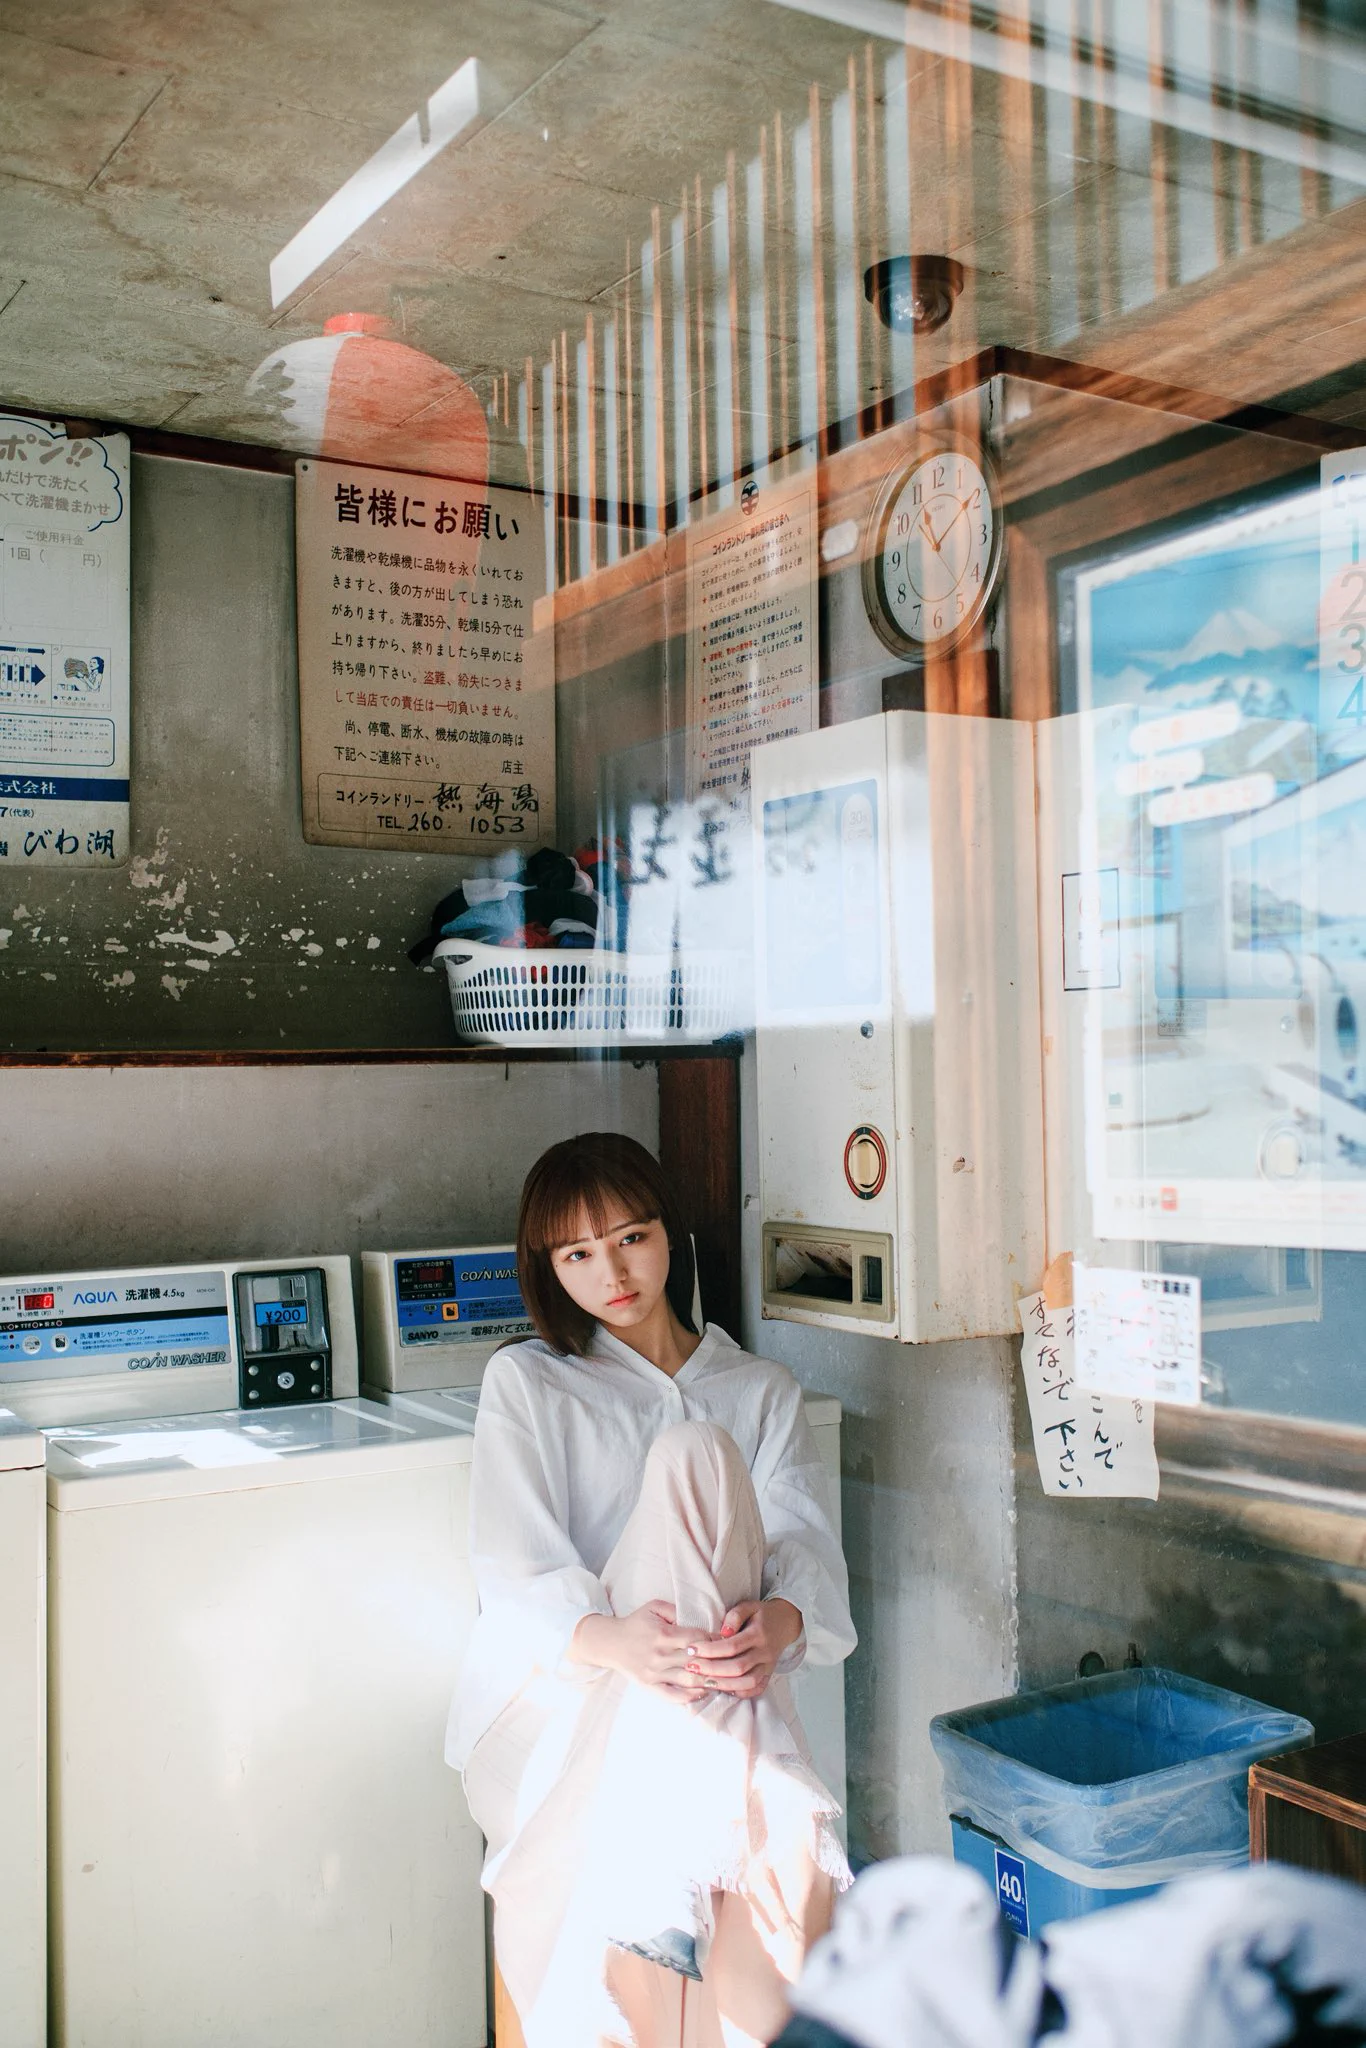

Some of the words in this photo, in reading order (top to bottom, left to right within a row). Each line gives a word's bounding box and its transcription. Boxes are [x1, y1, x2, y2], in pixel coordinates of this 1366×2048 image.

[931, 465, 945, 489] 12
[957, 469, 962, 490] 1
[912, 483, 923, 505] 11
[973, 488, 981, 509] 2
[334, 483, 519, 540] 皆様にお願い
[896, 512, 909, 536] 10
[979, 524, 987, 546] 3
[24, 530, 84, 546] ご使用料金
[331, 545, 523, 581] 洗濯機や乾燥機に品物を永くいれてお
[892, 551, 900, 572] 9
[971, 563, 980, 583] 4
[333, 574, 523, 609] きますと、後の方が出してしまう恐れ
[897, 584, 906, 605] 8
[956, 593, 964, 614] 5
[331, 603, 524, 638] があります。洗濯35分、乾燥15分で仕
[912, 604, 922, 626] 7
[933, 608, 942, 629] 6
[331, 631, 523, 663] 上りますから、終りましたら早めにお
[1337, 622, 1366, 674] 3
[332, 660, 523, 692] 持ち帰り下さい。盗難、紛失につきま
[335, 689, 519, 719] して当店での責任は一切負いません。
[1336, 675, 1366, 726] 4
[345, 720, 524, 746] 尚、停電、断水、機械の故障の時は
[334, 746, 441, 769] 下記へご連絡下さい。
[501, 760, 524, 775] 店主
[0, 780, 57, 795] 式会社
[336, 790, 424, 808] コインランドリー
[470, 816, 525, 833] 1053
[24, 828, 115, 859] びわ湖
[461, 1267, 492, 1281] COIN
[73, 1291, 118, 1305] AQUA
[125, 1287, 161, 1301] 洗濯機
[163, 1289, 185, 1299] 4.5kg
[265, 1309, 301, 1323] ¥200
[407, 1330, 439, 1341] SANYO
[128, 1352, 167, 1370] COIN
[170, 1350, 226, 1367] WASHER
[1030, 1297, 1083, 1489] すてないで下さい
[1000, 1871, 1022, 1903] 40
